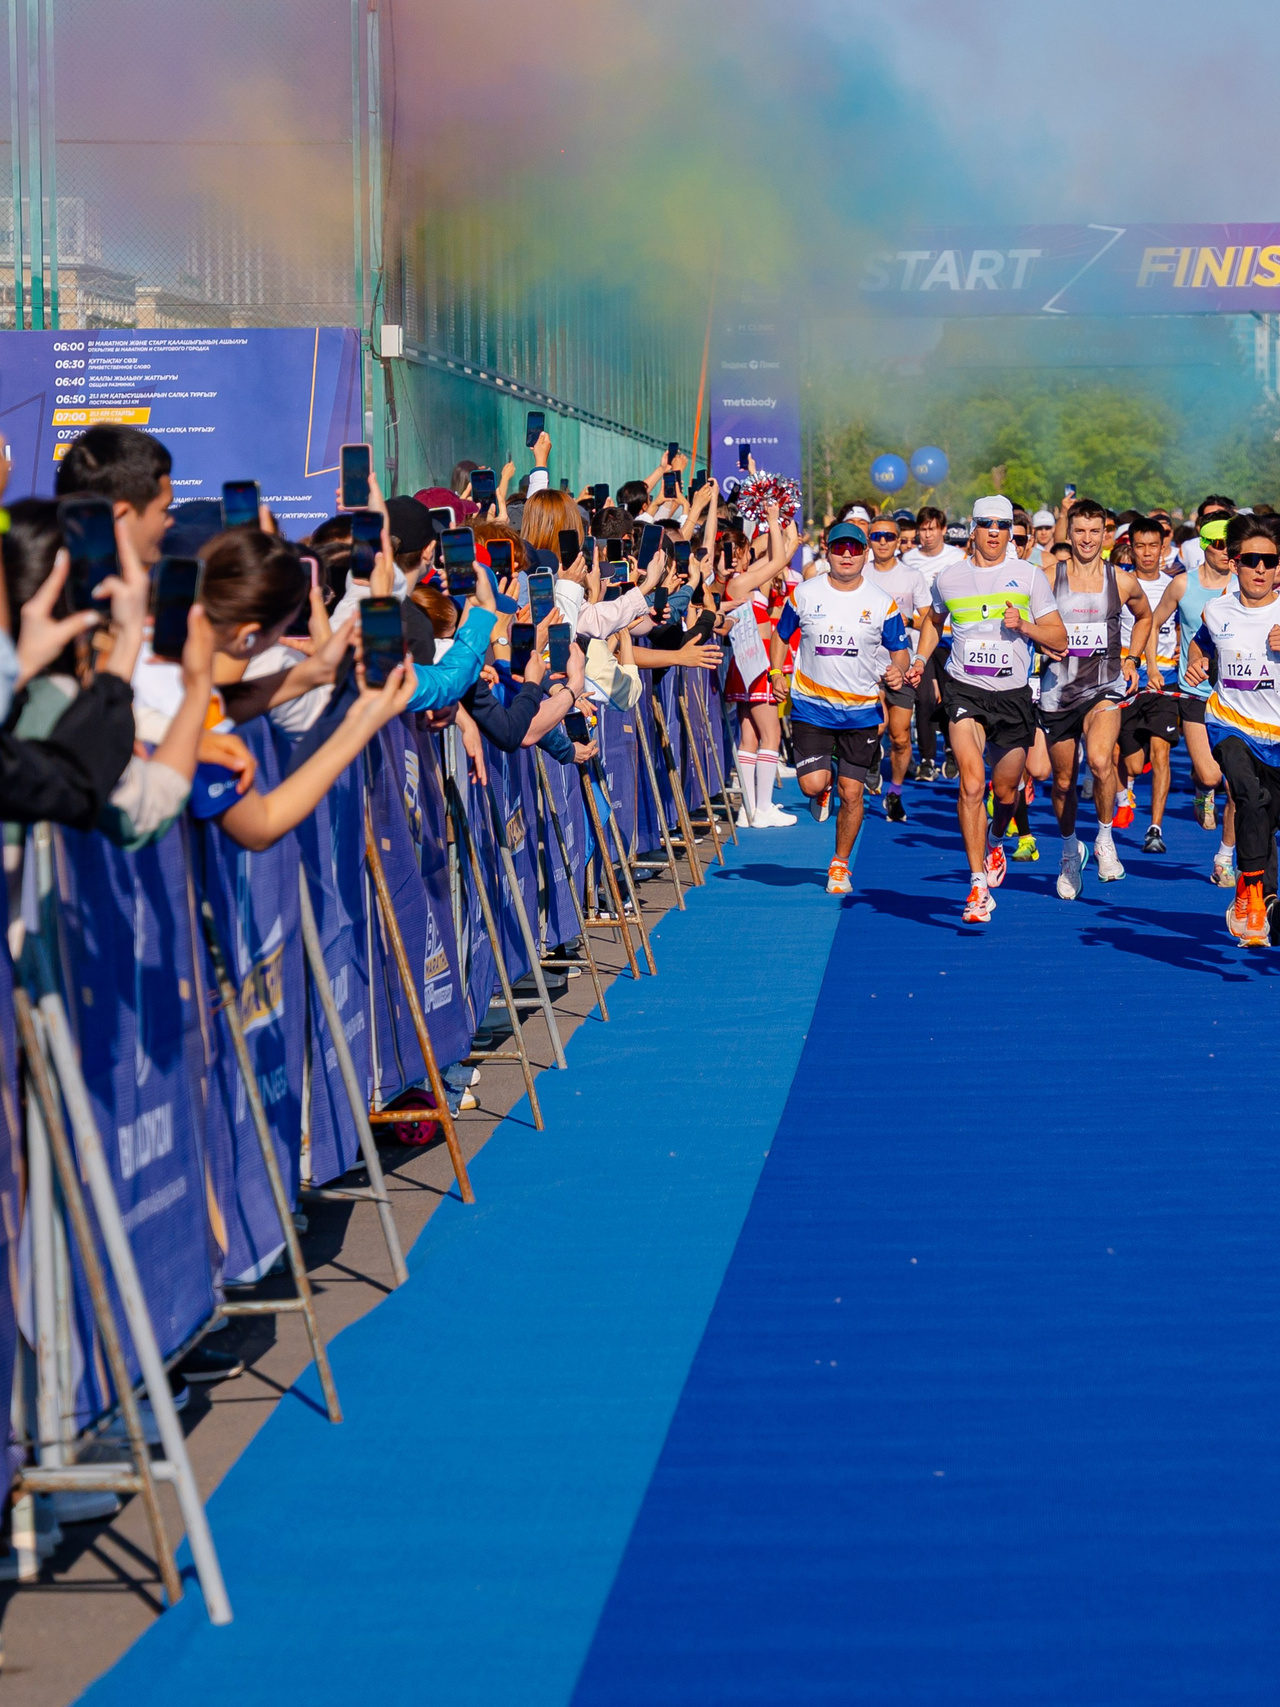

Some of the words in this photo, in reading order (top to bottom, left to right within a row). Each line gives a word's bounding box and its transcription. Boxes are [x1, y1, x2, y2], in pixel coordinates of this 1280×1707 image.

[858, 248, 1046, 291] START
[53, 342, 85, 352] 06:00
[55, 359, 85, 369] 06:30
[55, 377, 85, 387] 06:40
[56, 395, 86, 404] 06:50
[722, 397, 777, 409] metabody
[56, 412, 87, 422] 07:00
[819, 634, 843, 645] 1093
[847, 636, 855, 646] A
[1095, 634, 1103, 645] A
[969, 652, 996, 664] 2510
[1001, 653, 1009, 665] C
[1227, 663, 1252, 677] 1124
[1259, 664, 1269, 677] A
